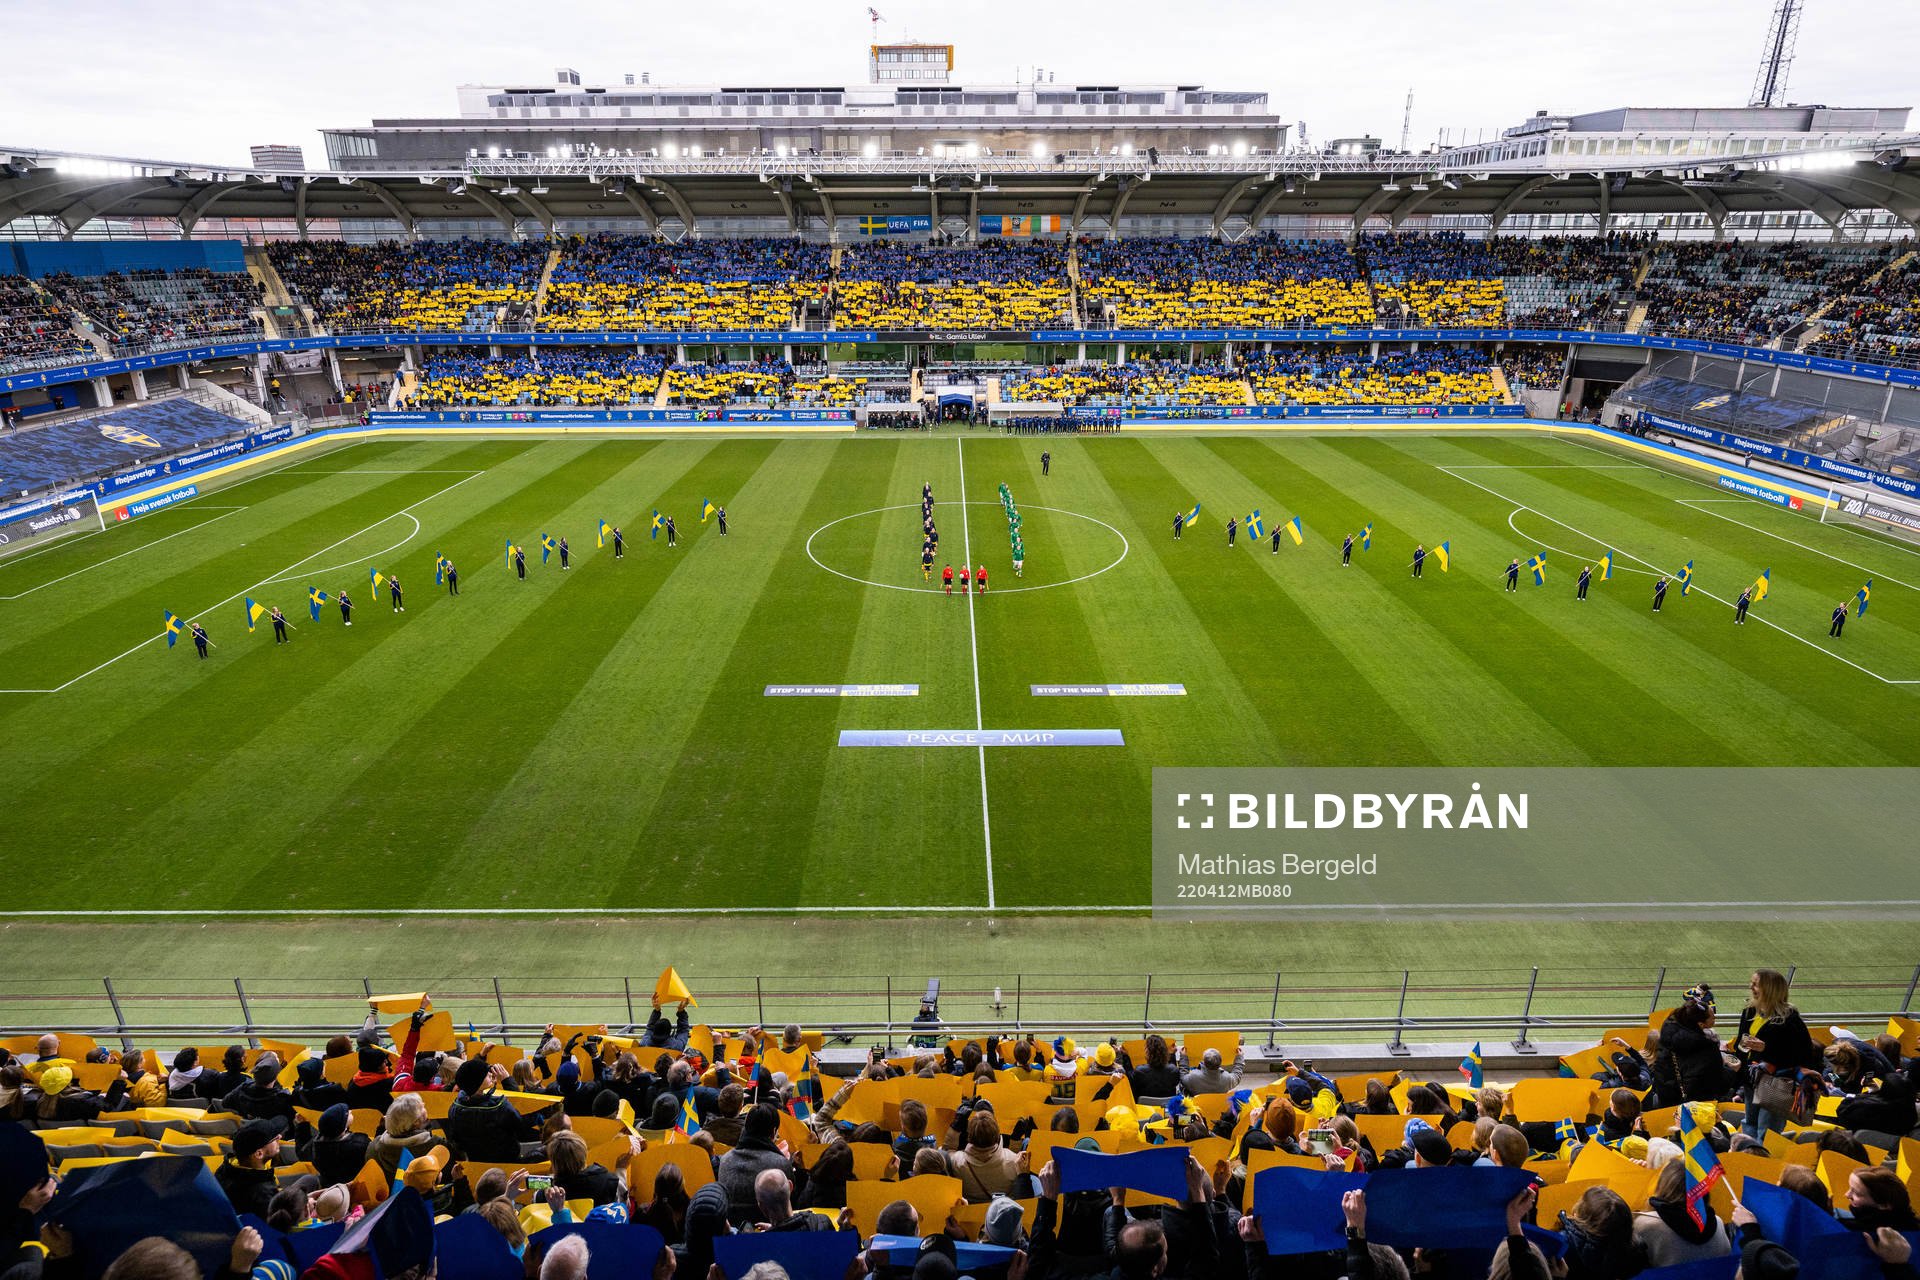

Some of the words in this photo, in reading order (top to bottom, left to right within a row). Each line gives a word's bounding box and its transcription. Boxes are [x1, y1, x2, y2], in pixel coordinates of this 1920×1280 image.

[261, 427, 290, 441] #hejasverige
[1651, 416, 1681, 430] Tillsammans
[1691, 426, 1713, 438] Sverige
[178, 451, 213, 466] Tillsammans
[224, 442, 244, 453] Sverige
[1734, 438, 1773, 453] #hejasverige
[115, 467, 156, 486] #hejasverige
[1820, 459, 1867, 478] Tillsammans
[1876, 475, 1885, 483] vi
[1884, 476, 1916, 492] Sverige
[1721, 477, 1736, 488] Heja
[1735, 483, 1758, 496] svensk
[132, 503, 149, 515] Heja
[149, 495, 172, 509] svensk
[1867, 507, 1890, 519] SKIVOR
[1890, 514, 1903, 523] TILL
[907, 733, 976, 743] PEACE
[1002, 733, 1055, 743] МИР
